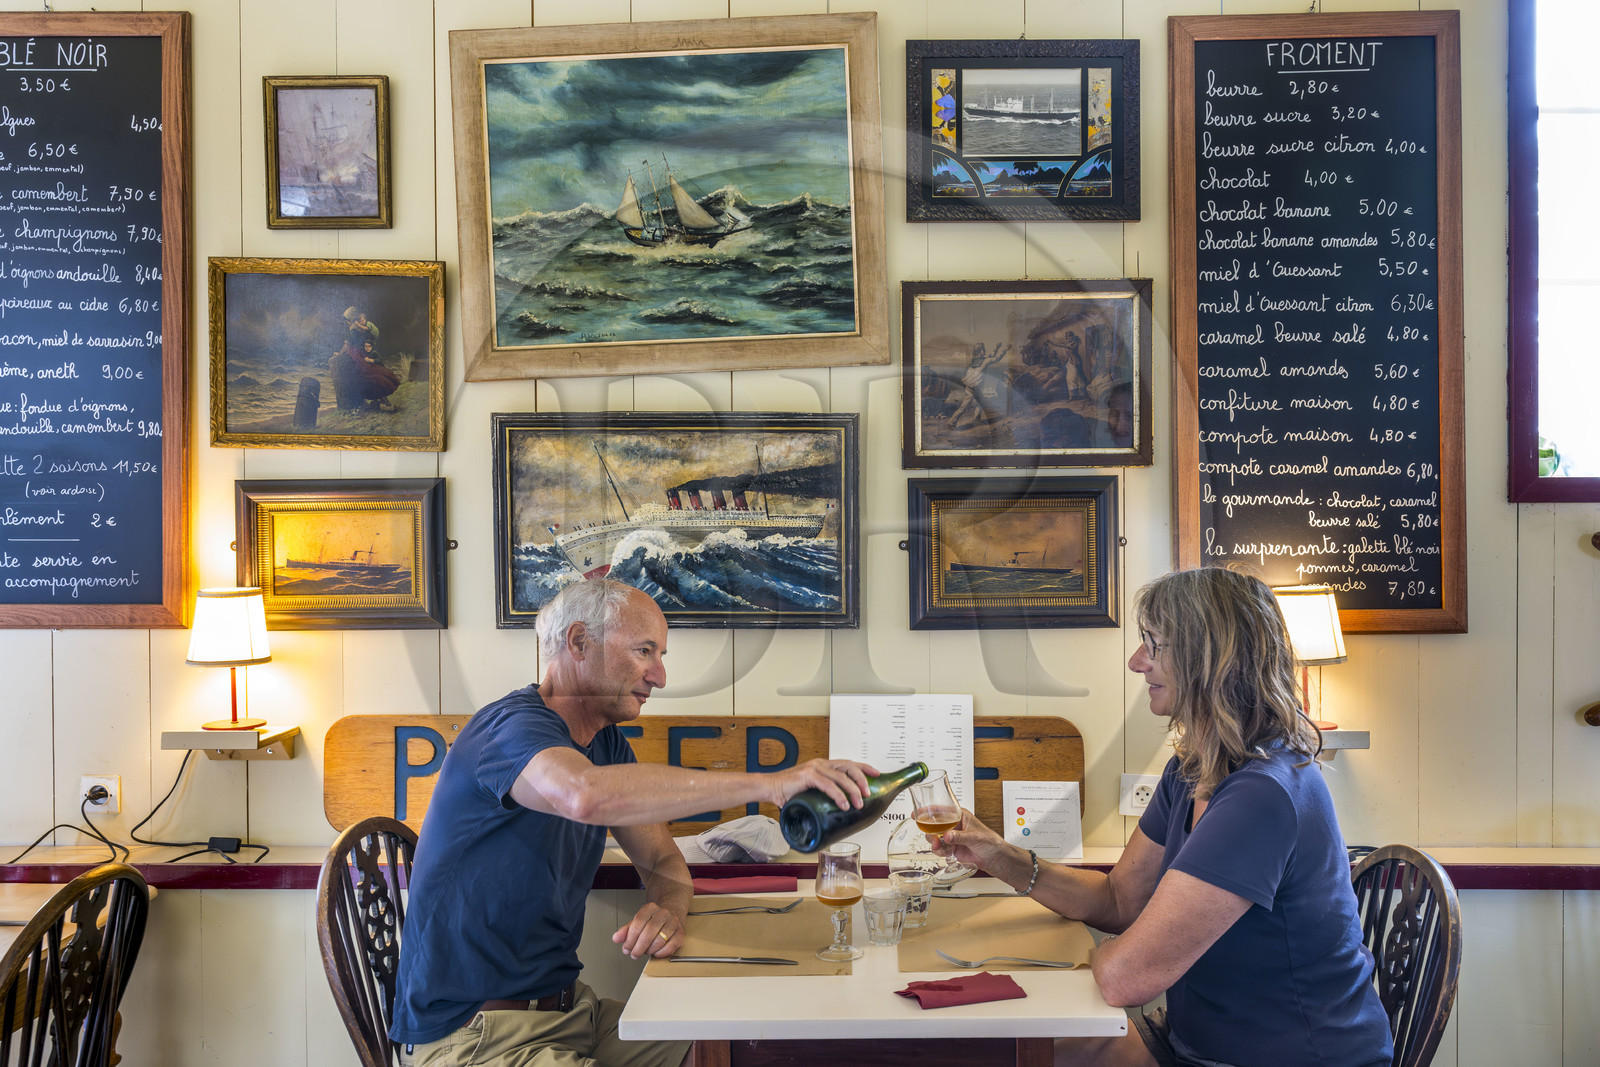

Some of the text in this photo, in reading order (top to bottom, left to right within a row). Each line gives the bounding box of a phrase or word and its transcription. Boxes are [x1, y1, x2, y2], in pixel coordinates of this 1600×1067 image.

[58, 39, 108, 67] NOIR
[1266, 42, 1383, 66] FROMENT
[1206, 70, 1262, 97] beurre
[0, 106, 35, 136] lgues
[1204, 101, 1256, 126] beurre
[1263, 110, 1311, 123] sucre
[1202, 132, 1255, 158] beurre
[1266, 140, 1314, 154] sucre
[1324, 134, 1375, 152] citron
[1200, 167, 1271, 189] chocolat
[12, 182, 88, 201] camembert
[1200, 200, 1267, 222] chocolat
[1273, 197, 1331, 218] banane
[15, 219, 117, 252] champignons
[1199, 229, 1257, 250] chocolat
[1261, 227, 1314, 248] banane
[1321, 232, 1378, 248] amandes
[57, 264, 121, 283] andouille
[1199, 259, 1240, 282] miel
[58, 302, 72, 310] au
[80, 297, 108, 311] cidre
[1199, 290, 1240, 314] miel
[1336, 295, 1374, 312] citron
[42, 330, 68, 346] miel
[72, 333, 83, 346] de
[87, 332, 144, 348] sarrasin
[1199, 324, 1264, 346] caramel
[1274, 322, 1322, 343] beurre
[1332, 323, 1366, 344] salé
[37, 362, 79, 379] aneth
[1199, 357, 1270, 379] caramel
[1280, 359, 1348, 379] amandes
[21, 393, 62, 422] fondue
[1200, 389, 1283, 422] confiture
[1290, 396, 1352, 410] maison
[62, 418, 134, 433] camembert
[1199, 425, 1278, 454] compote
[1284, 428, 1353, 442] maison
[33, 455, 42, 473] 2
[49, 460, 107, 473] saisons
[1199, 457, 1263, 486] compote
[1269, 456, 1328, 475] caramel
[1334, 459, 1402, 476] amandes
[1222, 489, 1315, 517] gourmande
[1326, 491, 1387, 511] chocolat,
[1390, 491, 1437, 507] caramel
[1309, 511, 1350, 528] beurre
[1356, 513, 1381, 528] salé
[1205, 527, 1227, 555] la
[1233, 534, 1340, 565] surprenante
[1394, 534, 1413, 554] blé
[32, 553, 82, 567] servie
[92, 555, 117, 565] en
[1296, 557, 1419, 580] pommes, caramel
[5, 570, 139, 598] accompagnement
